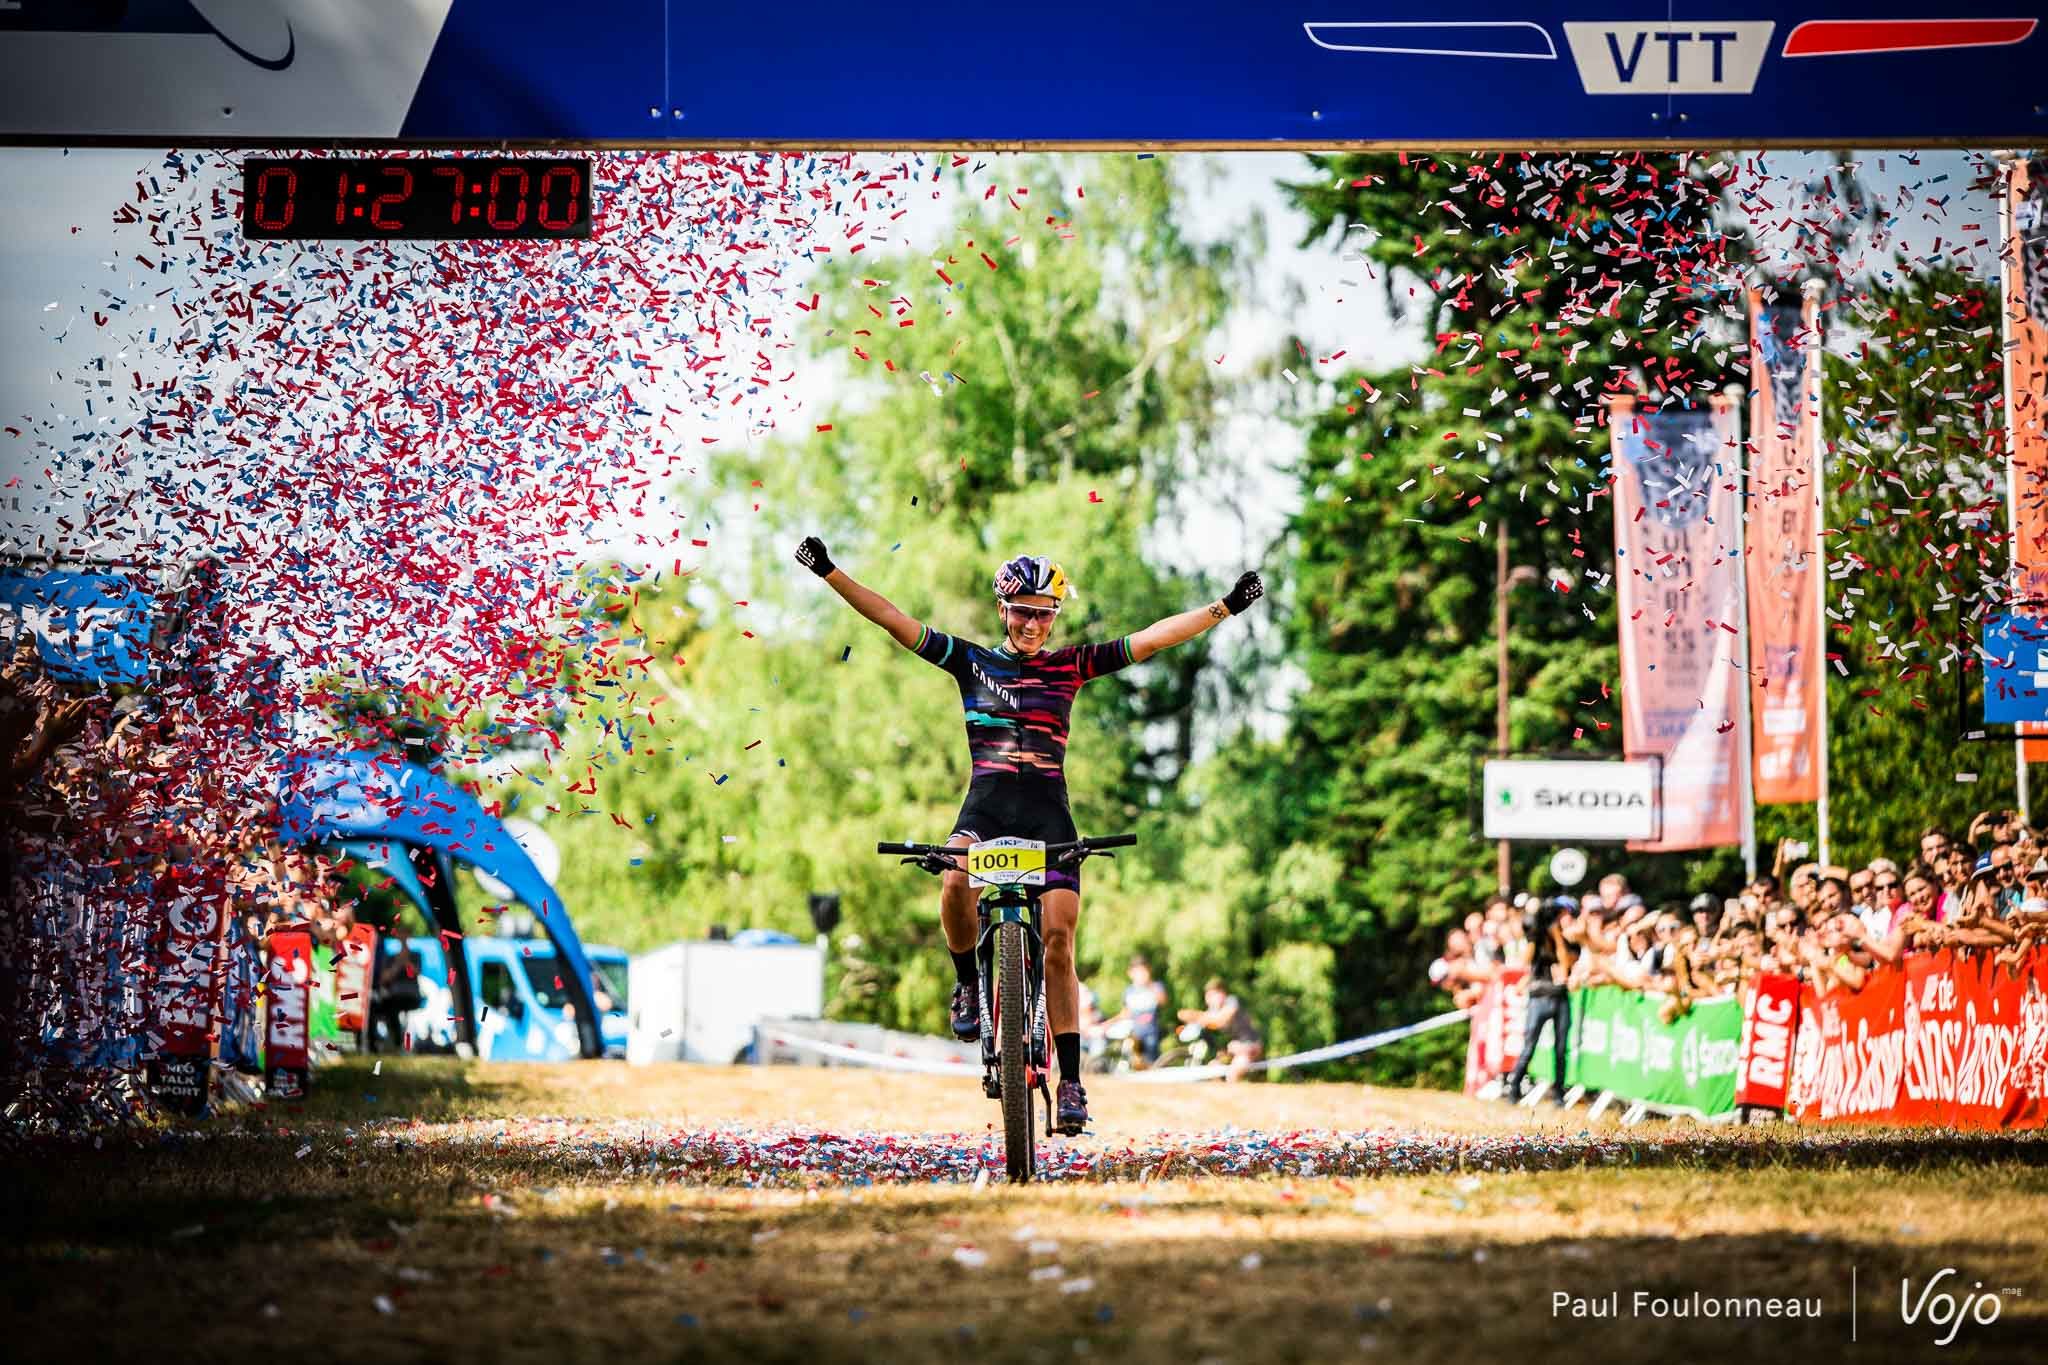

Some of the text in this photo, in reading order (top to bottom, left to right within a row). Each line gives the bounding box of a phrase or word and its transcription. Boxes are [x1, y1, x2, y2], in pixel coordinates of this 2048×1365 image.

[1604, 31, 1737, 83] VTT
[254, 166, 582, 231] 01:27:00
[972, 662, 1018, 710] CANYON
[971, 853, 1019, 870] 1001
[1748, 992, 1793, 1090] RMC
[159, 1075, 195, 1085] TALK
